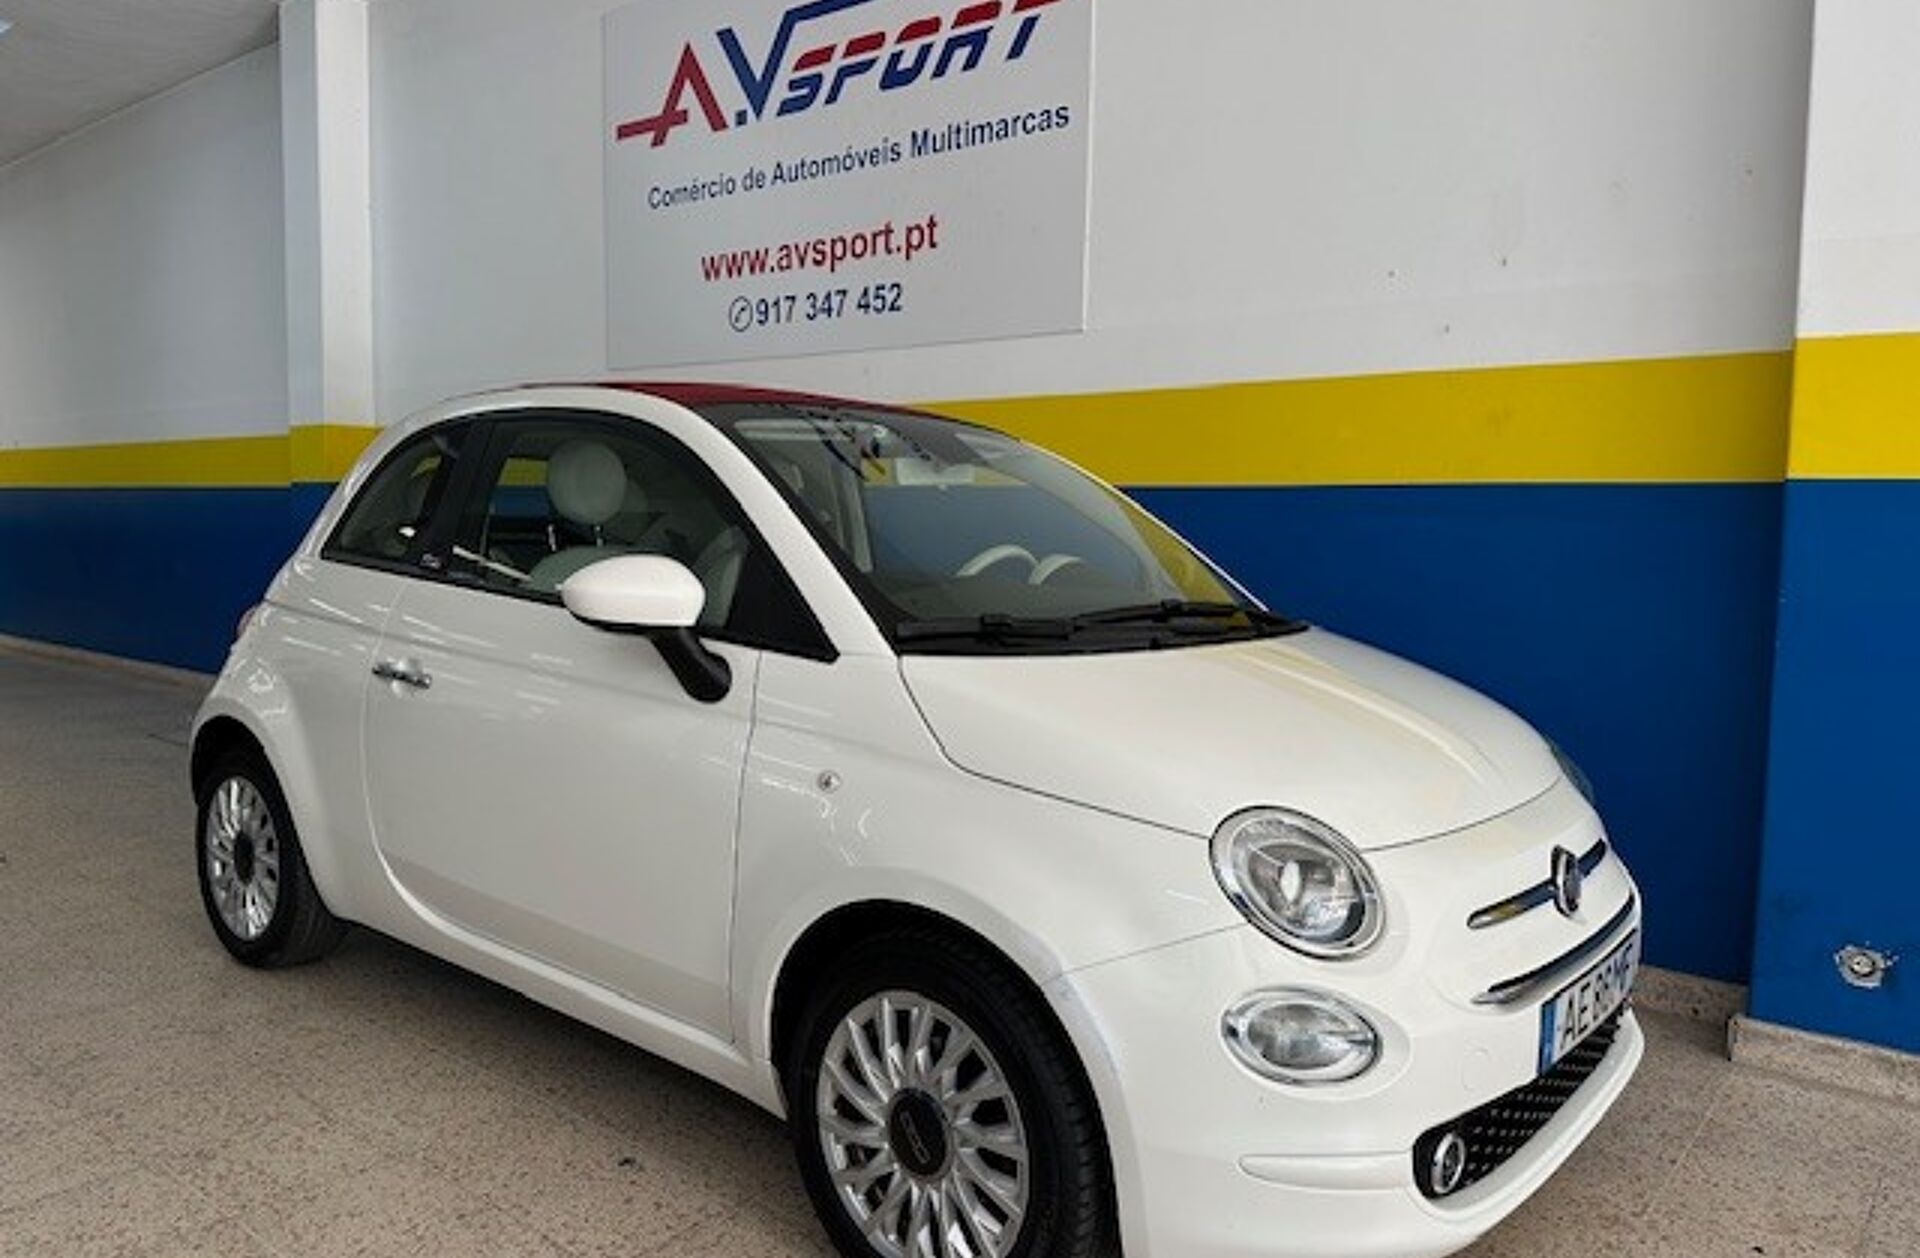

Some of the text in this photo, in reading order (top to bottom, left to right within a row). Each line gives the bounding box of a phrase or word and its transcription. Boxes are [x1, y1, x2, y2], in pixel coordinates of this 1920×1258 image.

[648, 105, 1070, 210] Comércio de Automóveis Multimarcas
[701, 214, 939, 281] www.avsport.pt
[756, 282, 904, 326] 917 347 452
